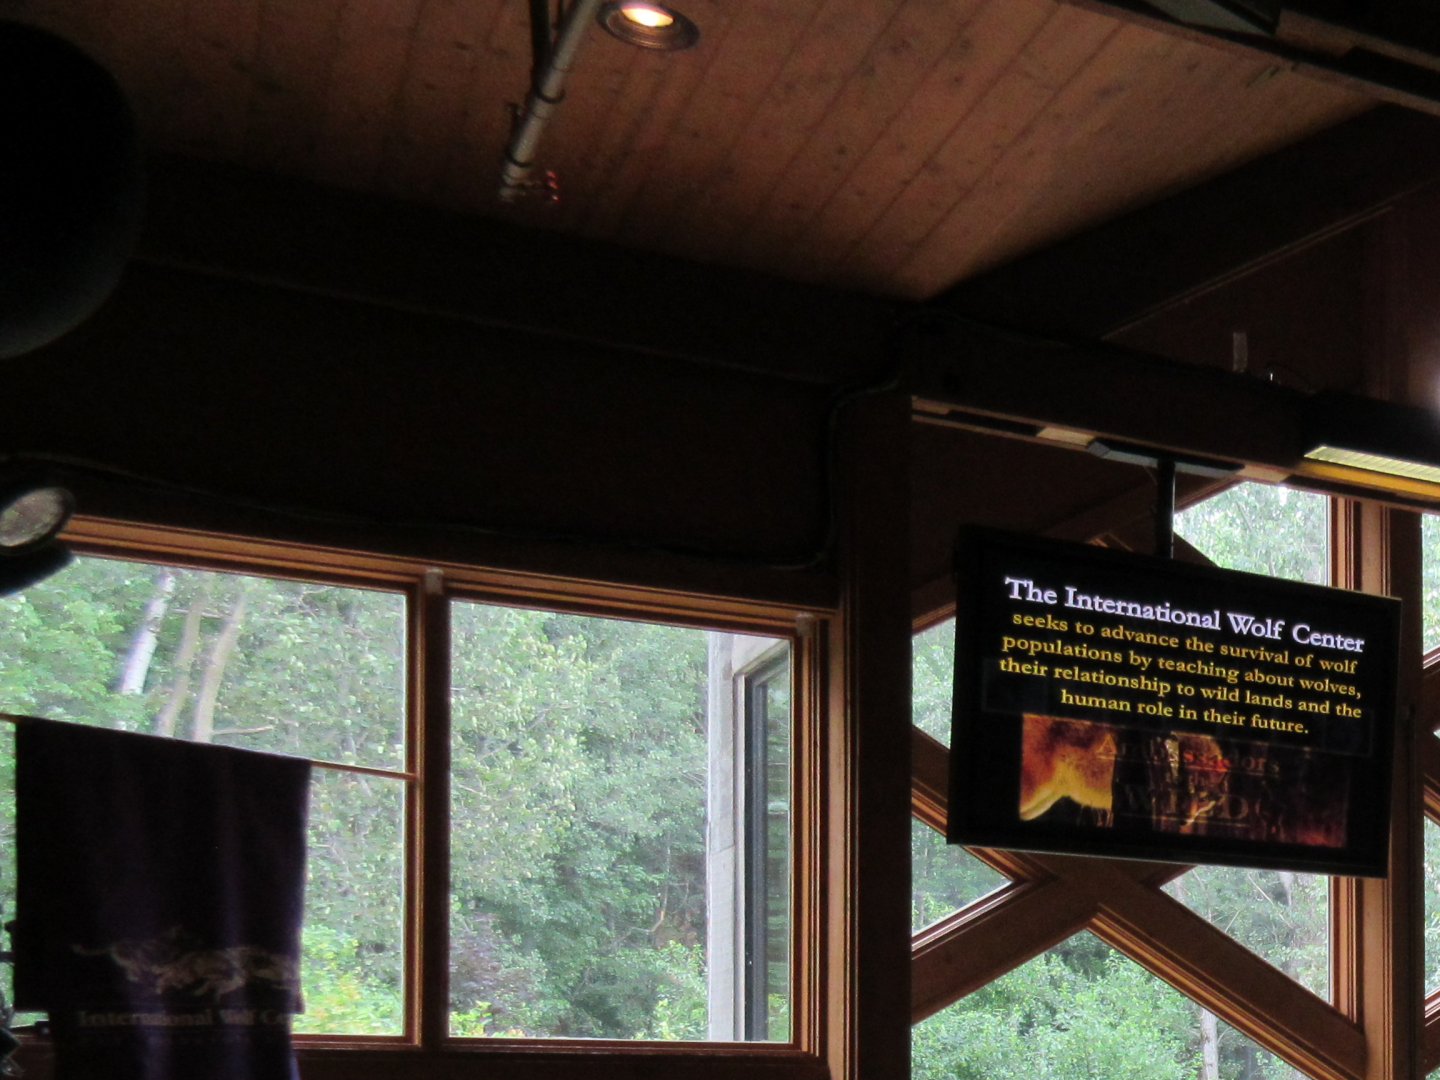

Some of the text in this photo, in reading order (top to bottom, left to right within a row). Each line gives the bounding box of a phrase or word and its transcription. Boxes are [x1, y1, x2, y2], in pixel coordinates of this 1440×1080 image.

[1005, 577, 1366, 653] The International Wolf Center
[1012, 613, 1358, 674] seeks to advance the survival of wolf
[999, 657, 1363, 719] their relationship to wild lands and the
[1002, 636, 1361, 699] populations by teaching about wolves,
[1060, 689, 1309, 734] human role in their future.
